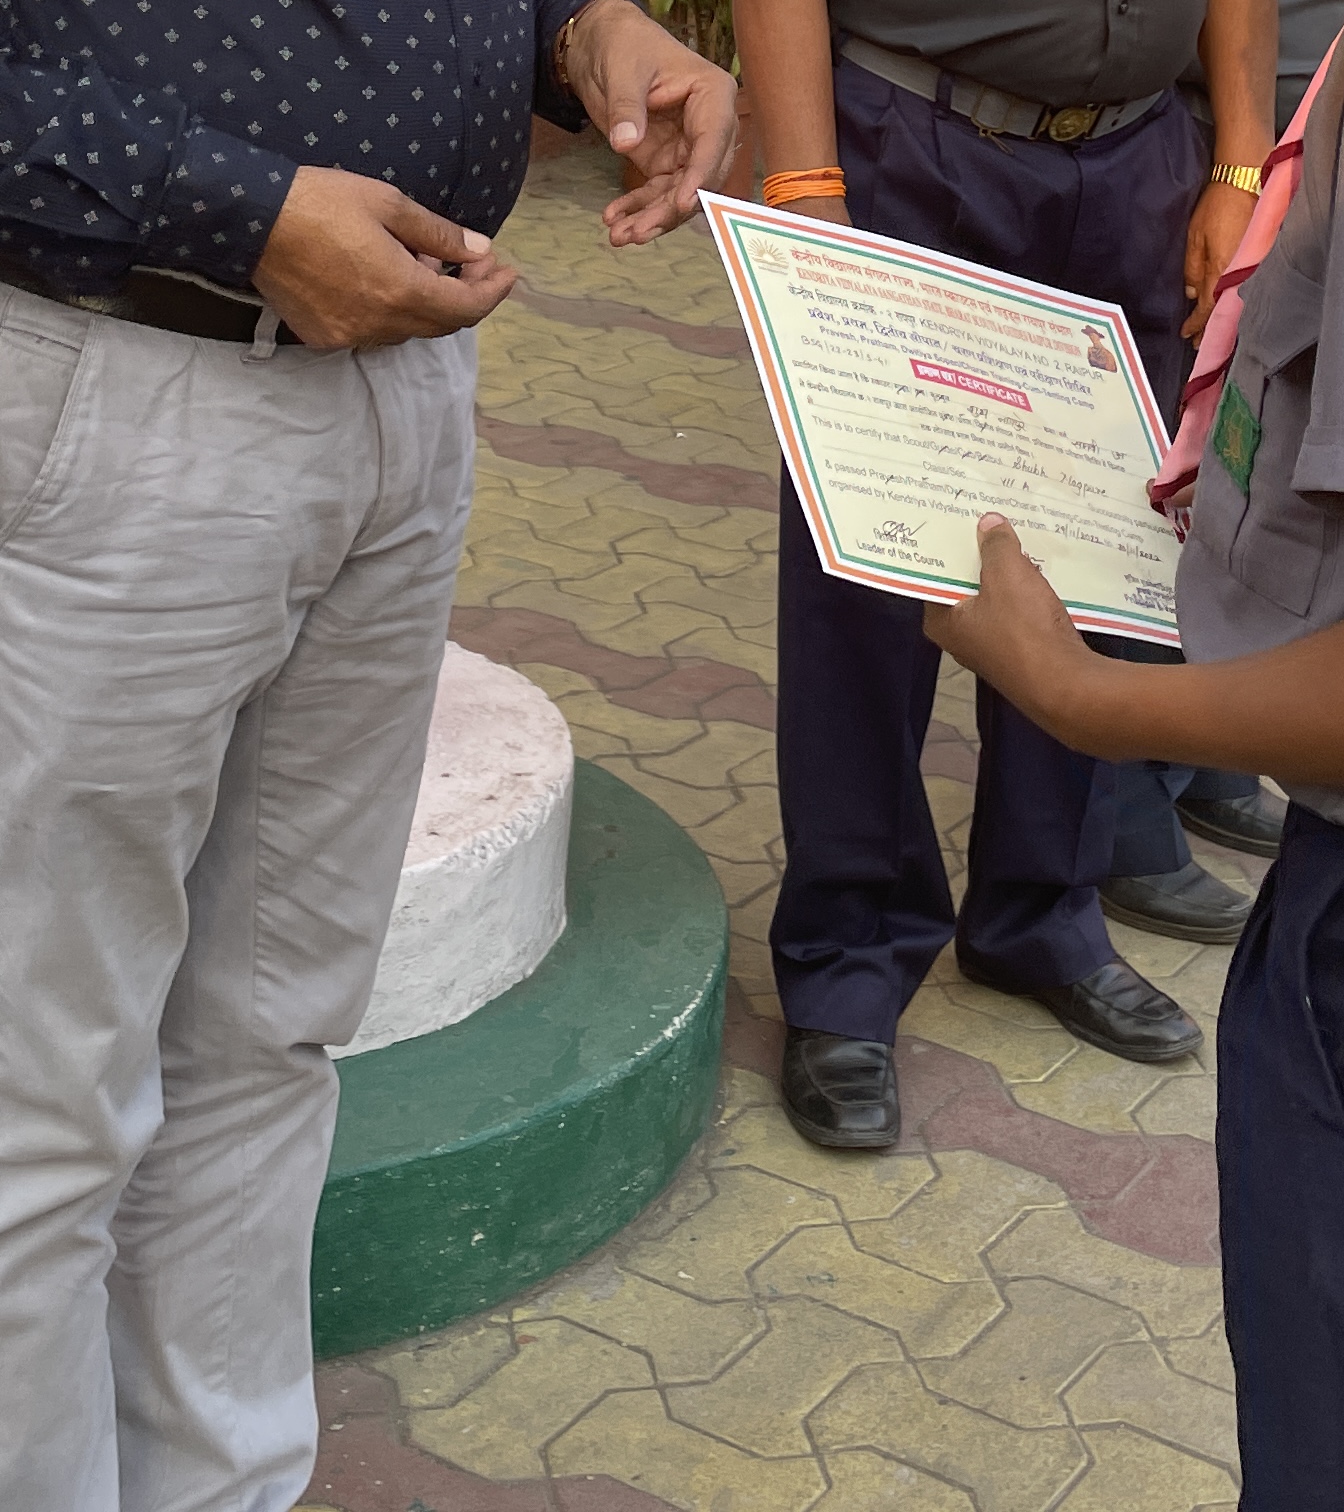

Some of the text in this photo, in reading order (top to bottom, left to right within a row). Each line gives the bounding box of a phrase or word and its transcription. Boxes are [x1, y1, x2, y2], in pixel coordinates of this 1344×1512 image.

[958, 375, 1026, 406] CERTIFICATE
[811, 415, 833, 428] This
[828, 480, 873, 496] organised
[887, 490, 927, 507] Kendriya
[928, 499, 970, 518] Vidyalaya
[856, 539, 885, 555] Leader
[898, 549, 912, 561] the
[913, 552, 945, 568] Course
